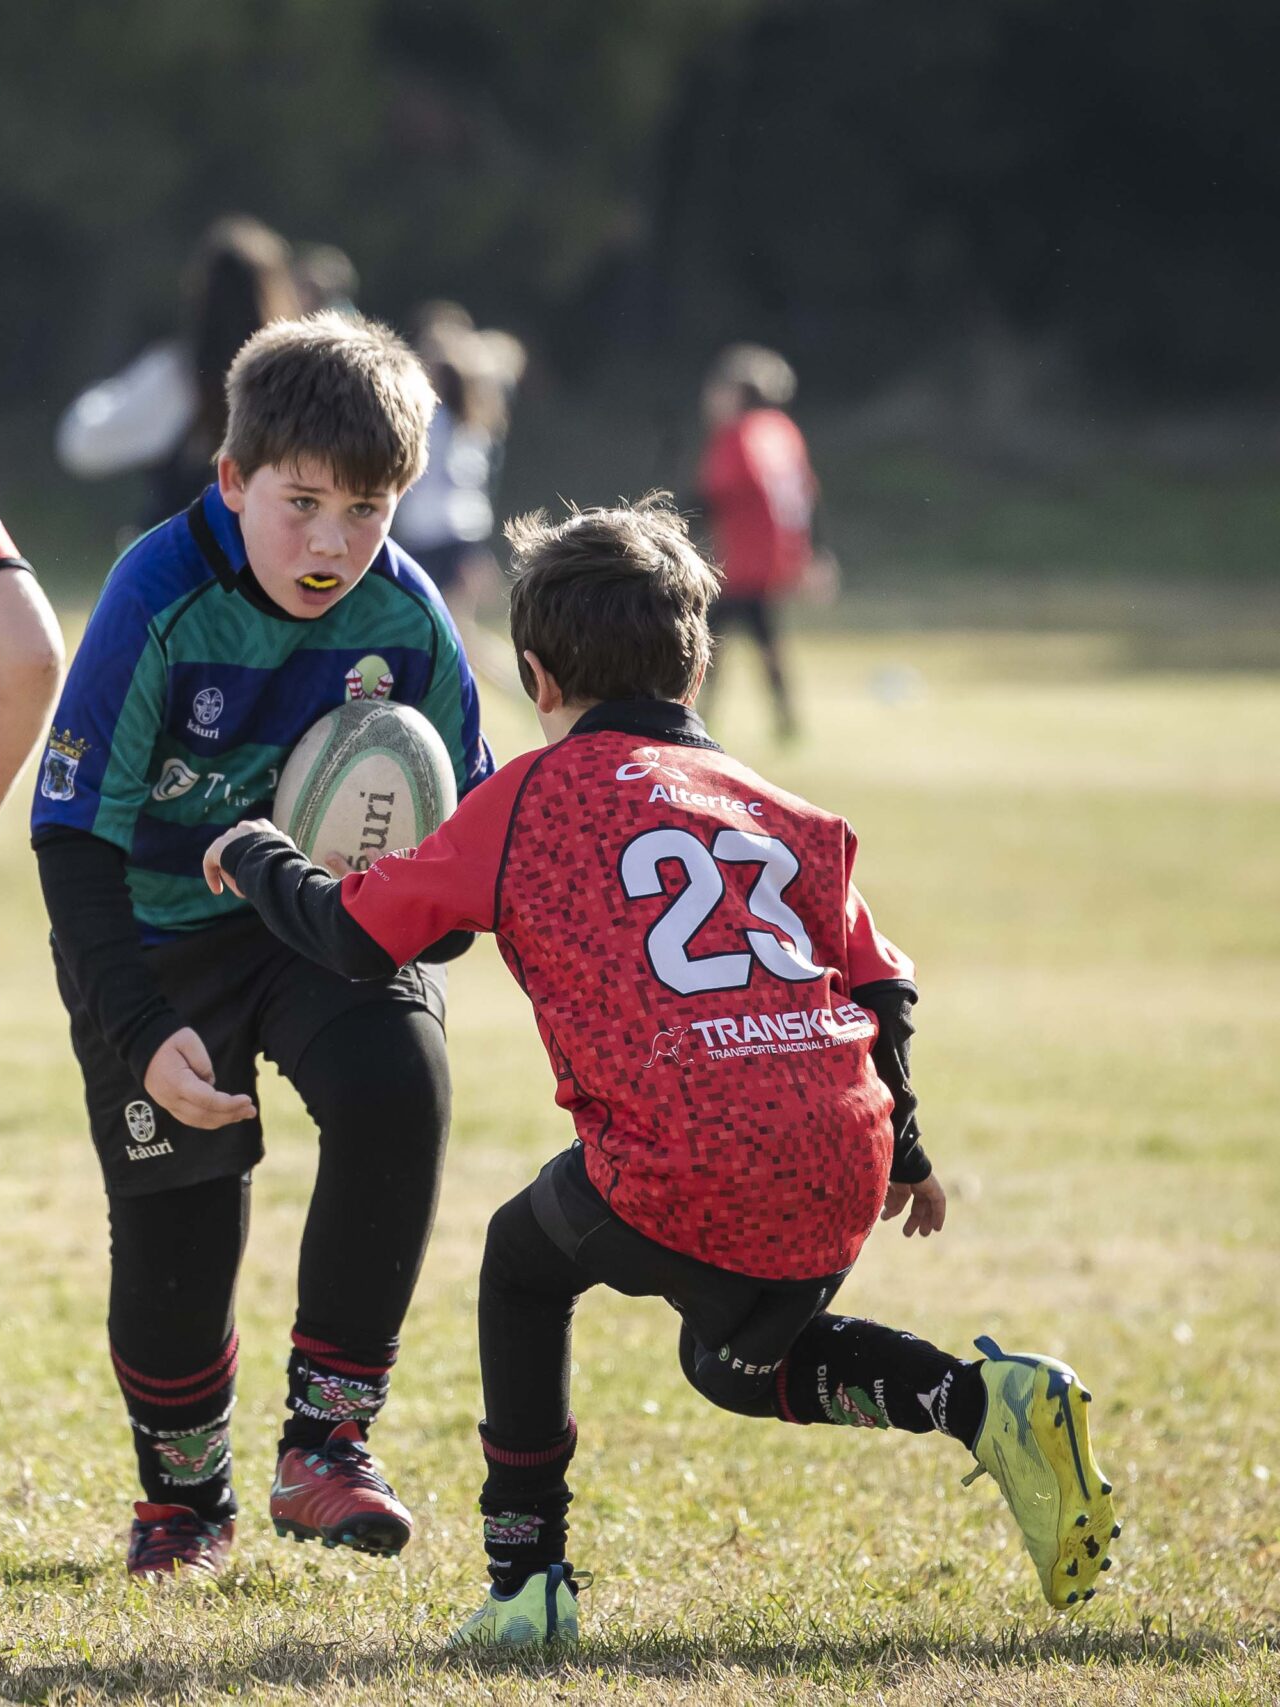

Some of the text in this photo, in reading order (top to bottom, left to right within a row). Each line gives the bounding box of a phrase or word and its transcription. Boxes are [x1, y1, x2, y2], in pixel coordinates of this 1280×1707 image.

[648, 784, 763, 816] Altertec
[618, 825, 825, 999] 23
[708, 1044, 778, 1061] TRANSPORTE
[778, 1040, 823, 1054] NACIONAL
[824, 1039, 831, 1048] E
